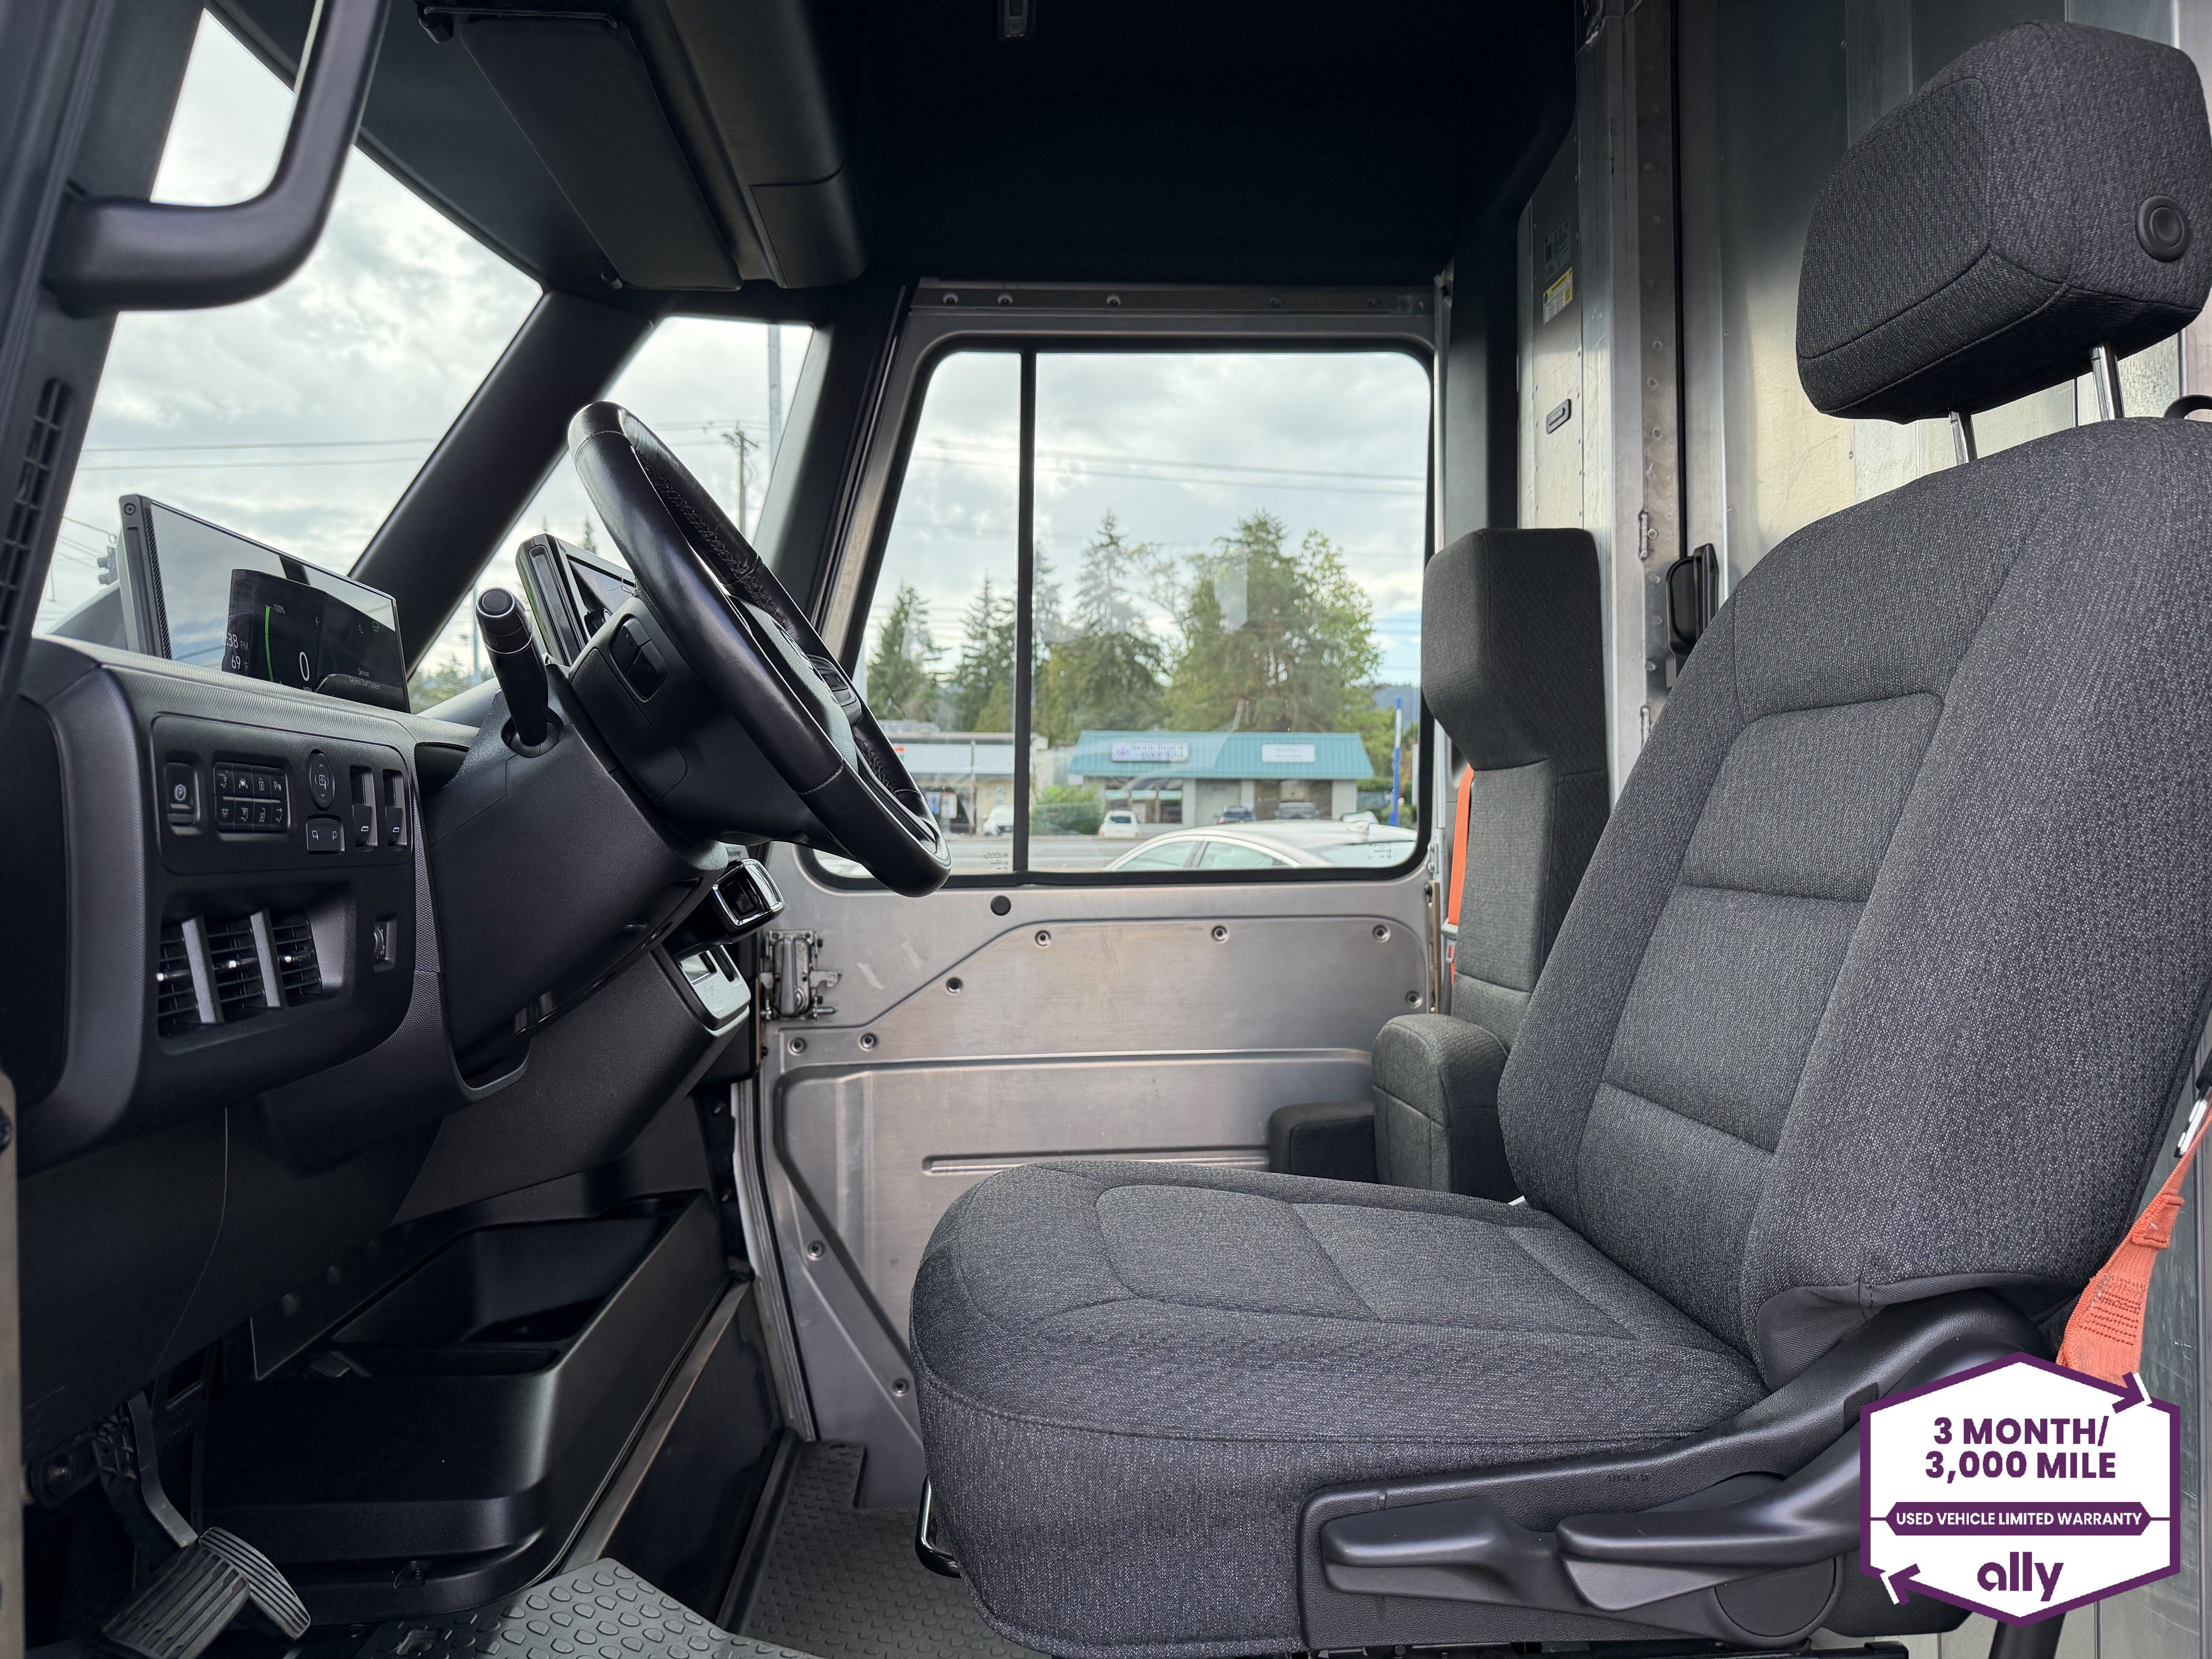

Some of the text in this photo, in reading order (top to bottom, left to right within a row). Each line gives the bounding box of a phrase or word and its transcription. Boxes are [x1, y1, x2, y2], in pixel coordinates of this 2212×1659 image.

[273, 604, 285, 614] 100%
[232, 655, 241, 670] 69
[299, 651, 310, 682] 0
